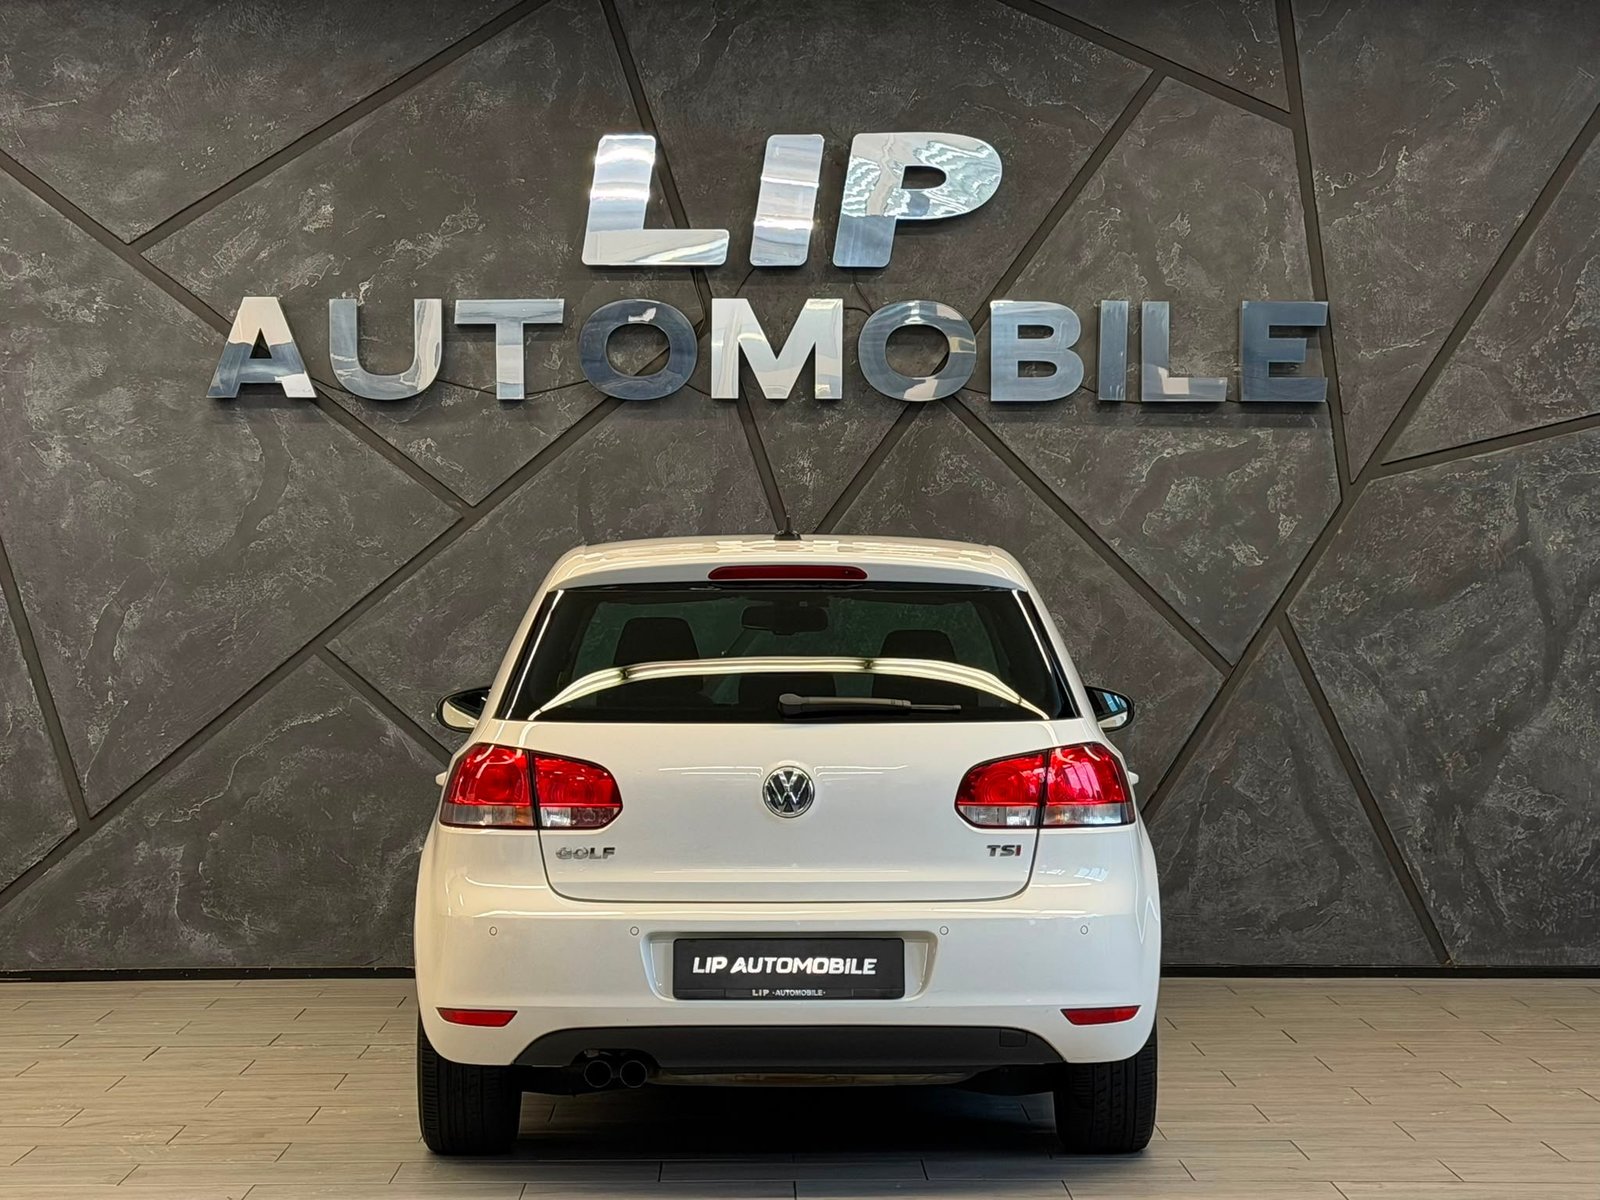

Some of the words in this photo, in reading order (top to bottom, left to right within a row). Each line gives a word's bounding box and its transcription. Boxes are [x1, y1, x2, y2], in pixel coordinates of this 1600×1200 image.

[581, 131, 1003, 268] LIP
[206, 296, 1329, 402] AUTOMOBILE
[764, 767, 813, 815] VW
[555, 847, 616, 860] GOLF
[986, 844, 1022, 857] TSI
[692, 956, 728, 974] LIP
[730, 957, 877, 975] AUTOMOBILE
[752, 988, 769, 997] LIP
